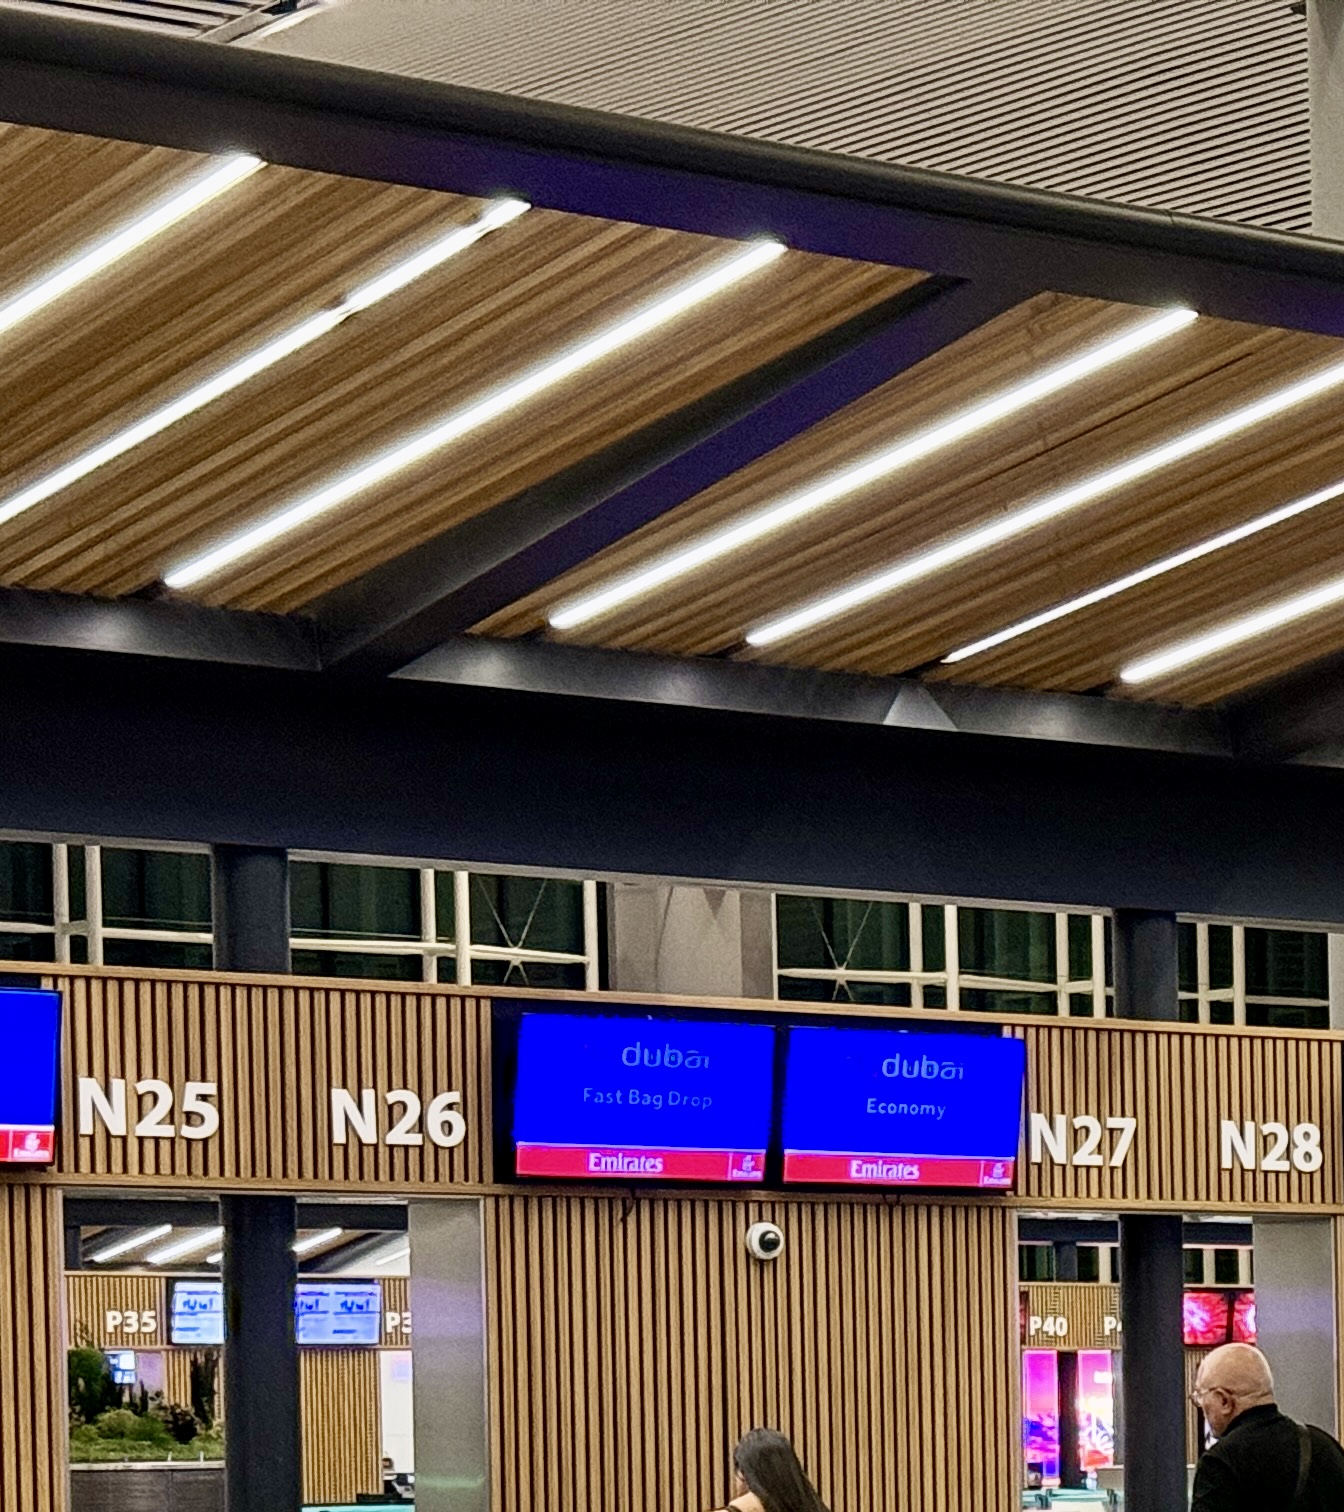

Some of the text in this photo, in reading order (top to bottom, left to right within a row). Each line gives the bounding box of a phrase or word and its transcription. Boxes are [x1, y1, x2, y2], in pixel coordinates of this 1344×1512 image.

[78, 1077, 221, 1140] N25
[583, 1087, 713, 1110] Fast Bag Drop
[866, 1098, 946, 1120] Economy
[331, 1088, 467, 1148] N26
[1030, 1113, 1137, 1167] N27
[1221, 1120, 1323, 1173] N28
[588, 1152, 663, 1174] Emirates
[850, 1160, 920, 1180] Emirates
[105, 1310, 157, 1333] P35
[385, 1311, 412, 1334] P3
[1029, 1316, 1068, 1337] P40
